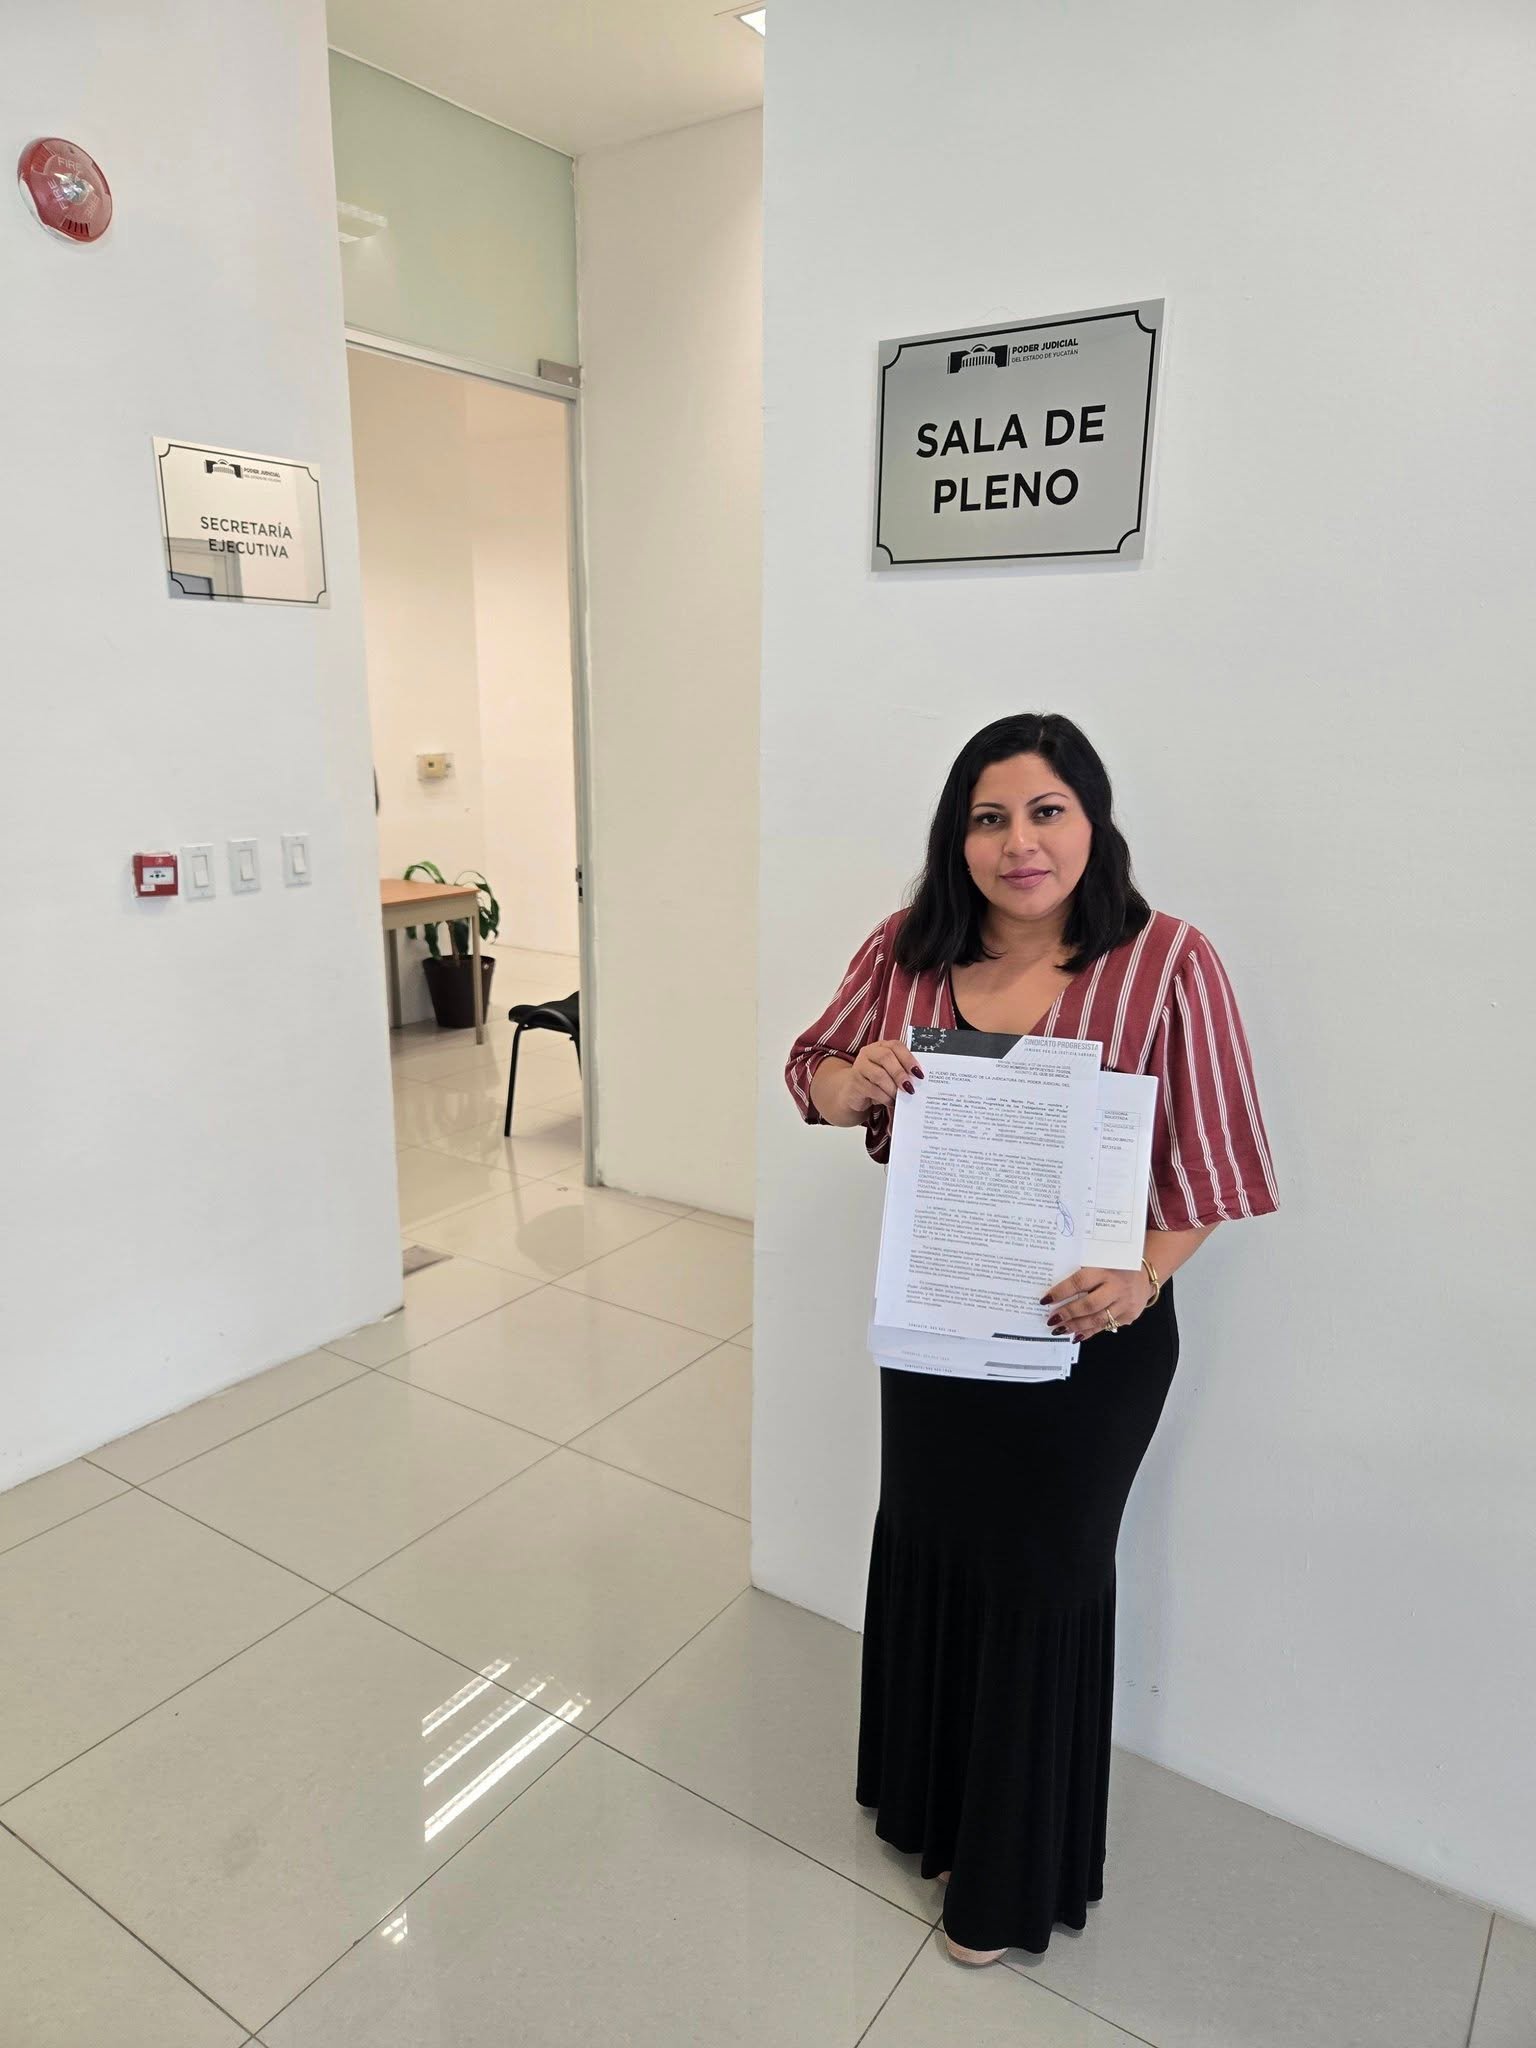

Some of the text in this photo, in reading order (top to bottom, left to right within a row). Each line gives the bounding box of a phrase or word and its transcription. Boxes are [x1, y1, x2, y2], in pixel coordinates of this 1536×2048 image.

[1012, 338, 1079, 355] PODER JUDICIAL
[1022, 353, 1044, 362] ESTADO
[915, 404, 1106, 458] SALA DE
[933, 468, 1079, 514] PLENO
[200, 516, 293, 540] SECRETARÍA
[208, 538, 289, 559] EJECUTIVA
[1023, 1038, 1099, 1051] SINDICATO PROGRESISTA
